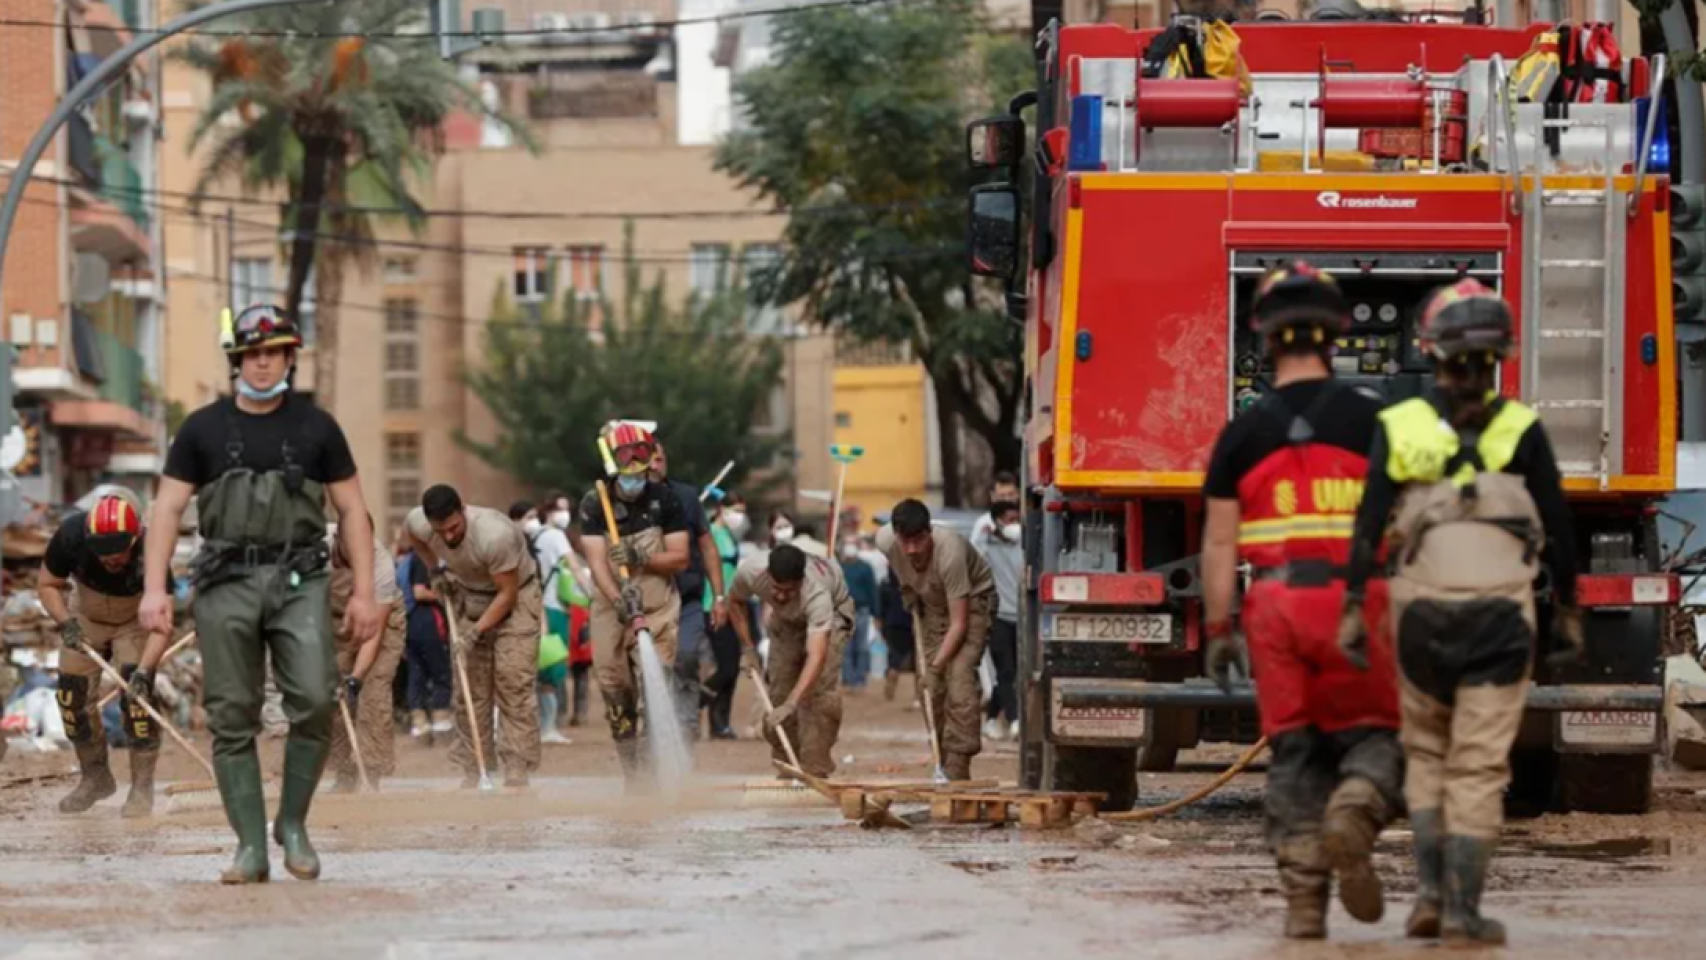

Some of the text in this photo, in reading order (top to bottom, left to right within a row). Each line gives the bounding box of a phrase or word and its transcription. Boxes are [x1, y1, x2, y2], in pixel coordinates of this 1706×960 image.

[1341, 194, 1418, 208] rosenbauer
[1056, 616, 1166, 639] ET 120932
